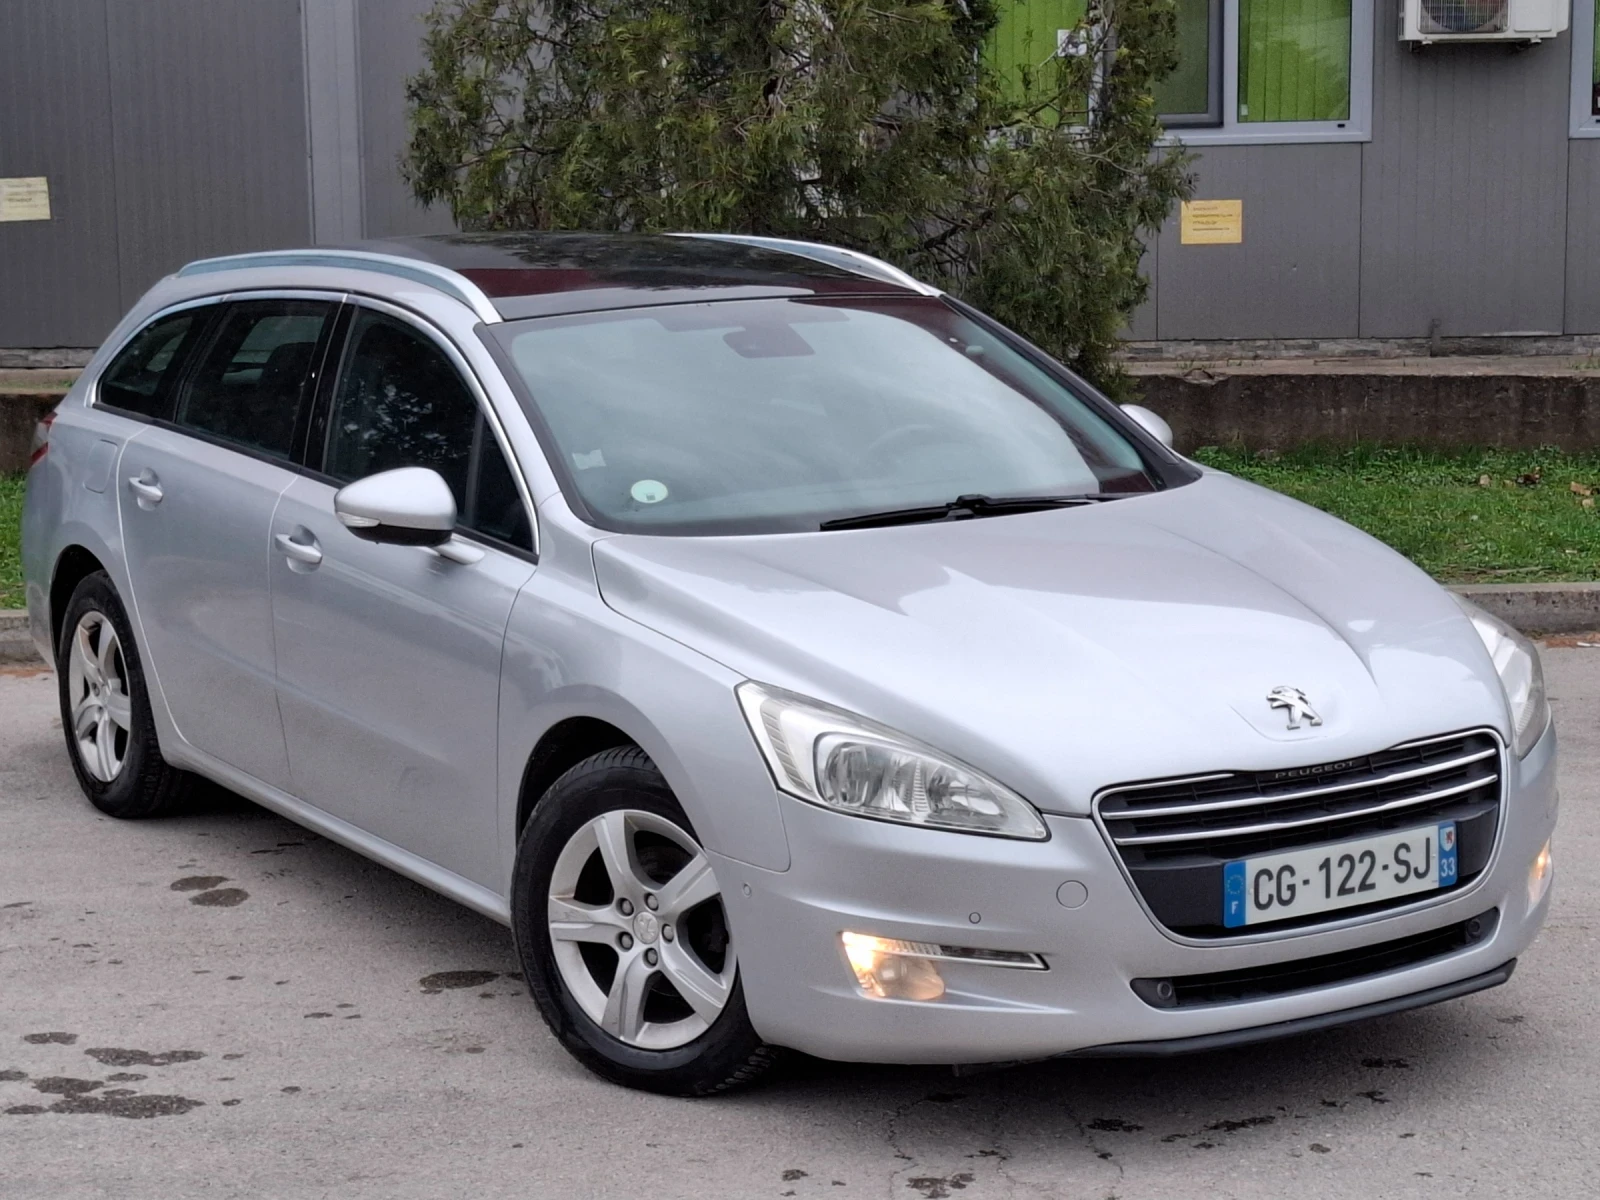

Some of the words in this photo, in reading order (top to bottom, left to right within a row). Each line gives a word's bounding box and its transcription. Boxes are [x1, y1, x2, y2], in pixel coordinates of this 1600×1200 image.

[1275, 761, 1356, 779] PEUGEOT
[1254, 838, 1431, 910] CG-122-SJ
[1440, 858, 1455, 877] 33
[1230, 901, 1238, 915] F
